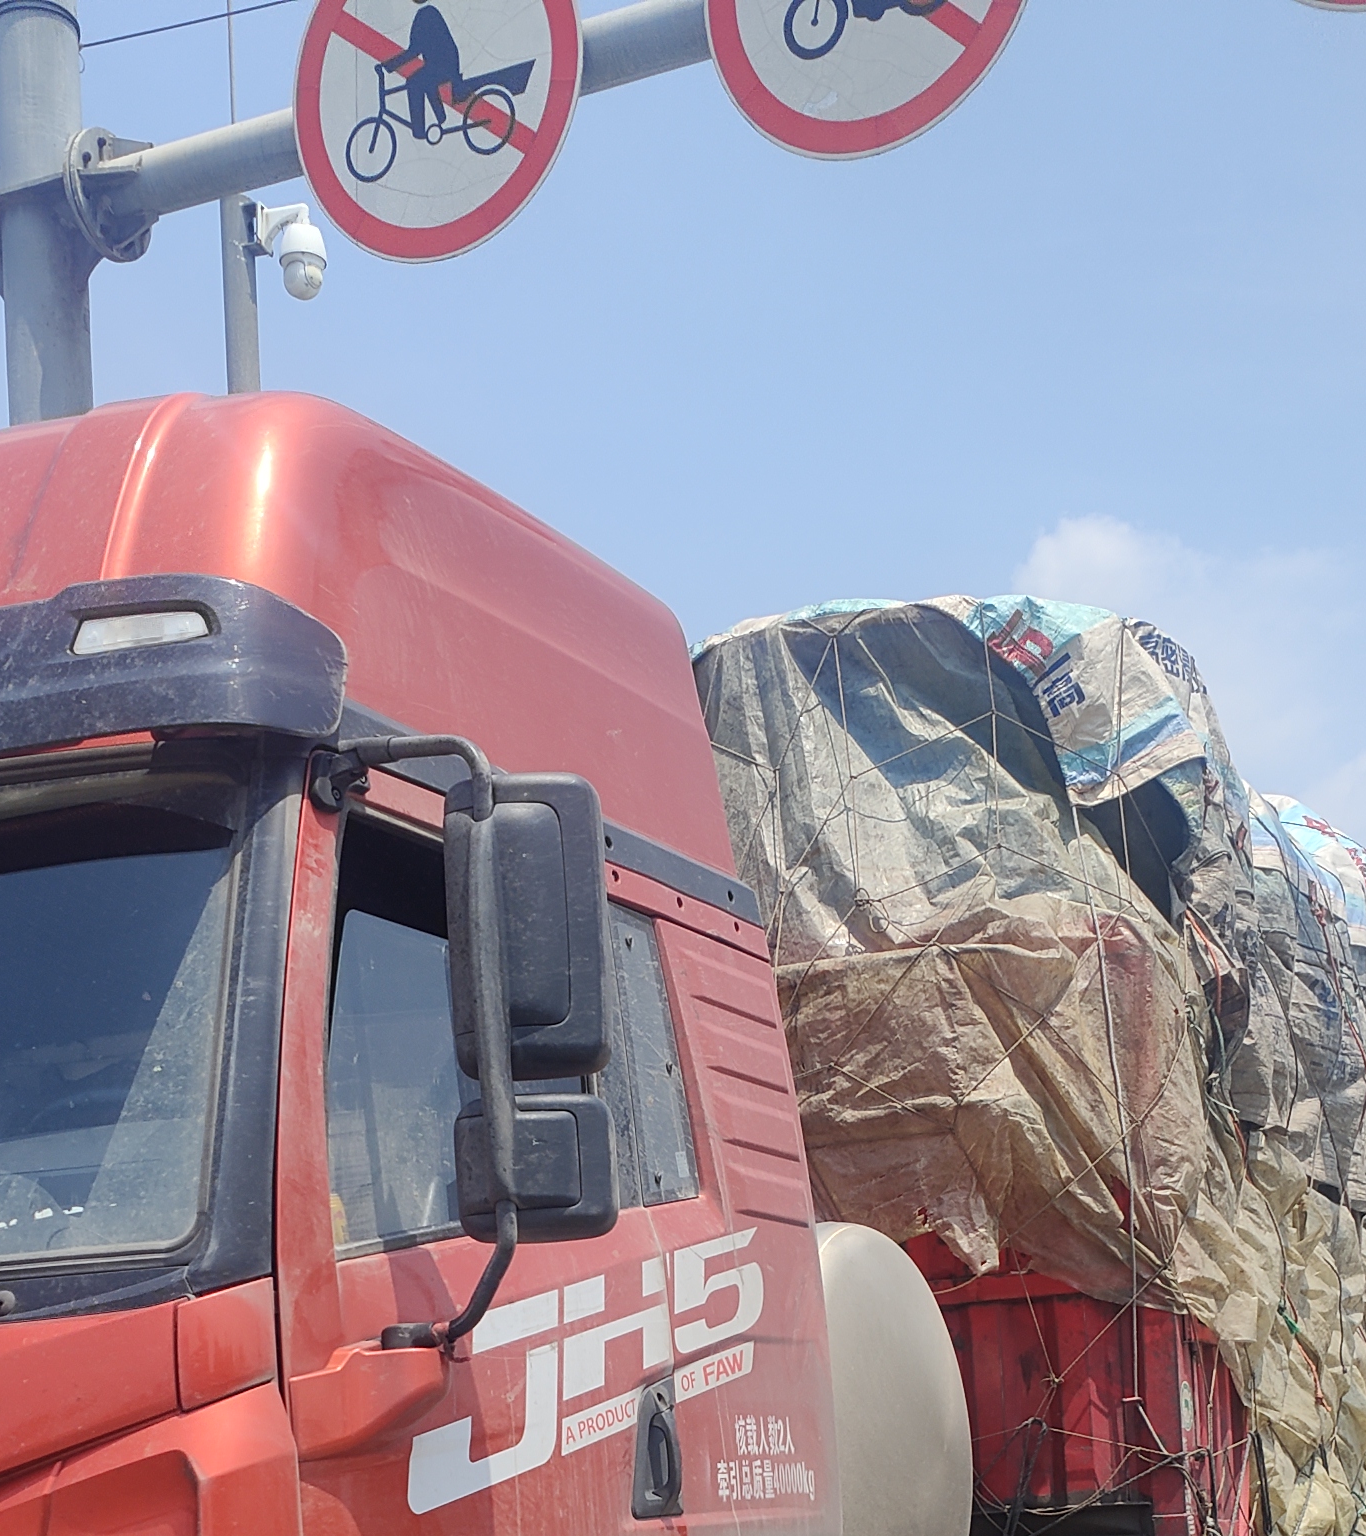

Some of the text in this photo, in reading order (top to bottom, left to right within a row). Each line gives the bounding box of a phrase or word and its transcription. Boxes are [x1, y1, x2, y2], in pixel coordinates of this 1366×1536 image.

[407, 1227, 765, 1515] JH5
[565, 1350, 744, 1445] A PRODUCT OF FAW
[735, 1414, 795, 1456] 核载人数2人
[716, 1458, 815, 1502] 牵引总质量40000kg
